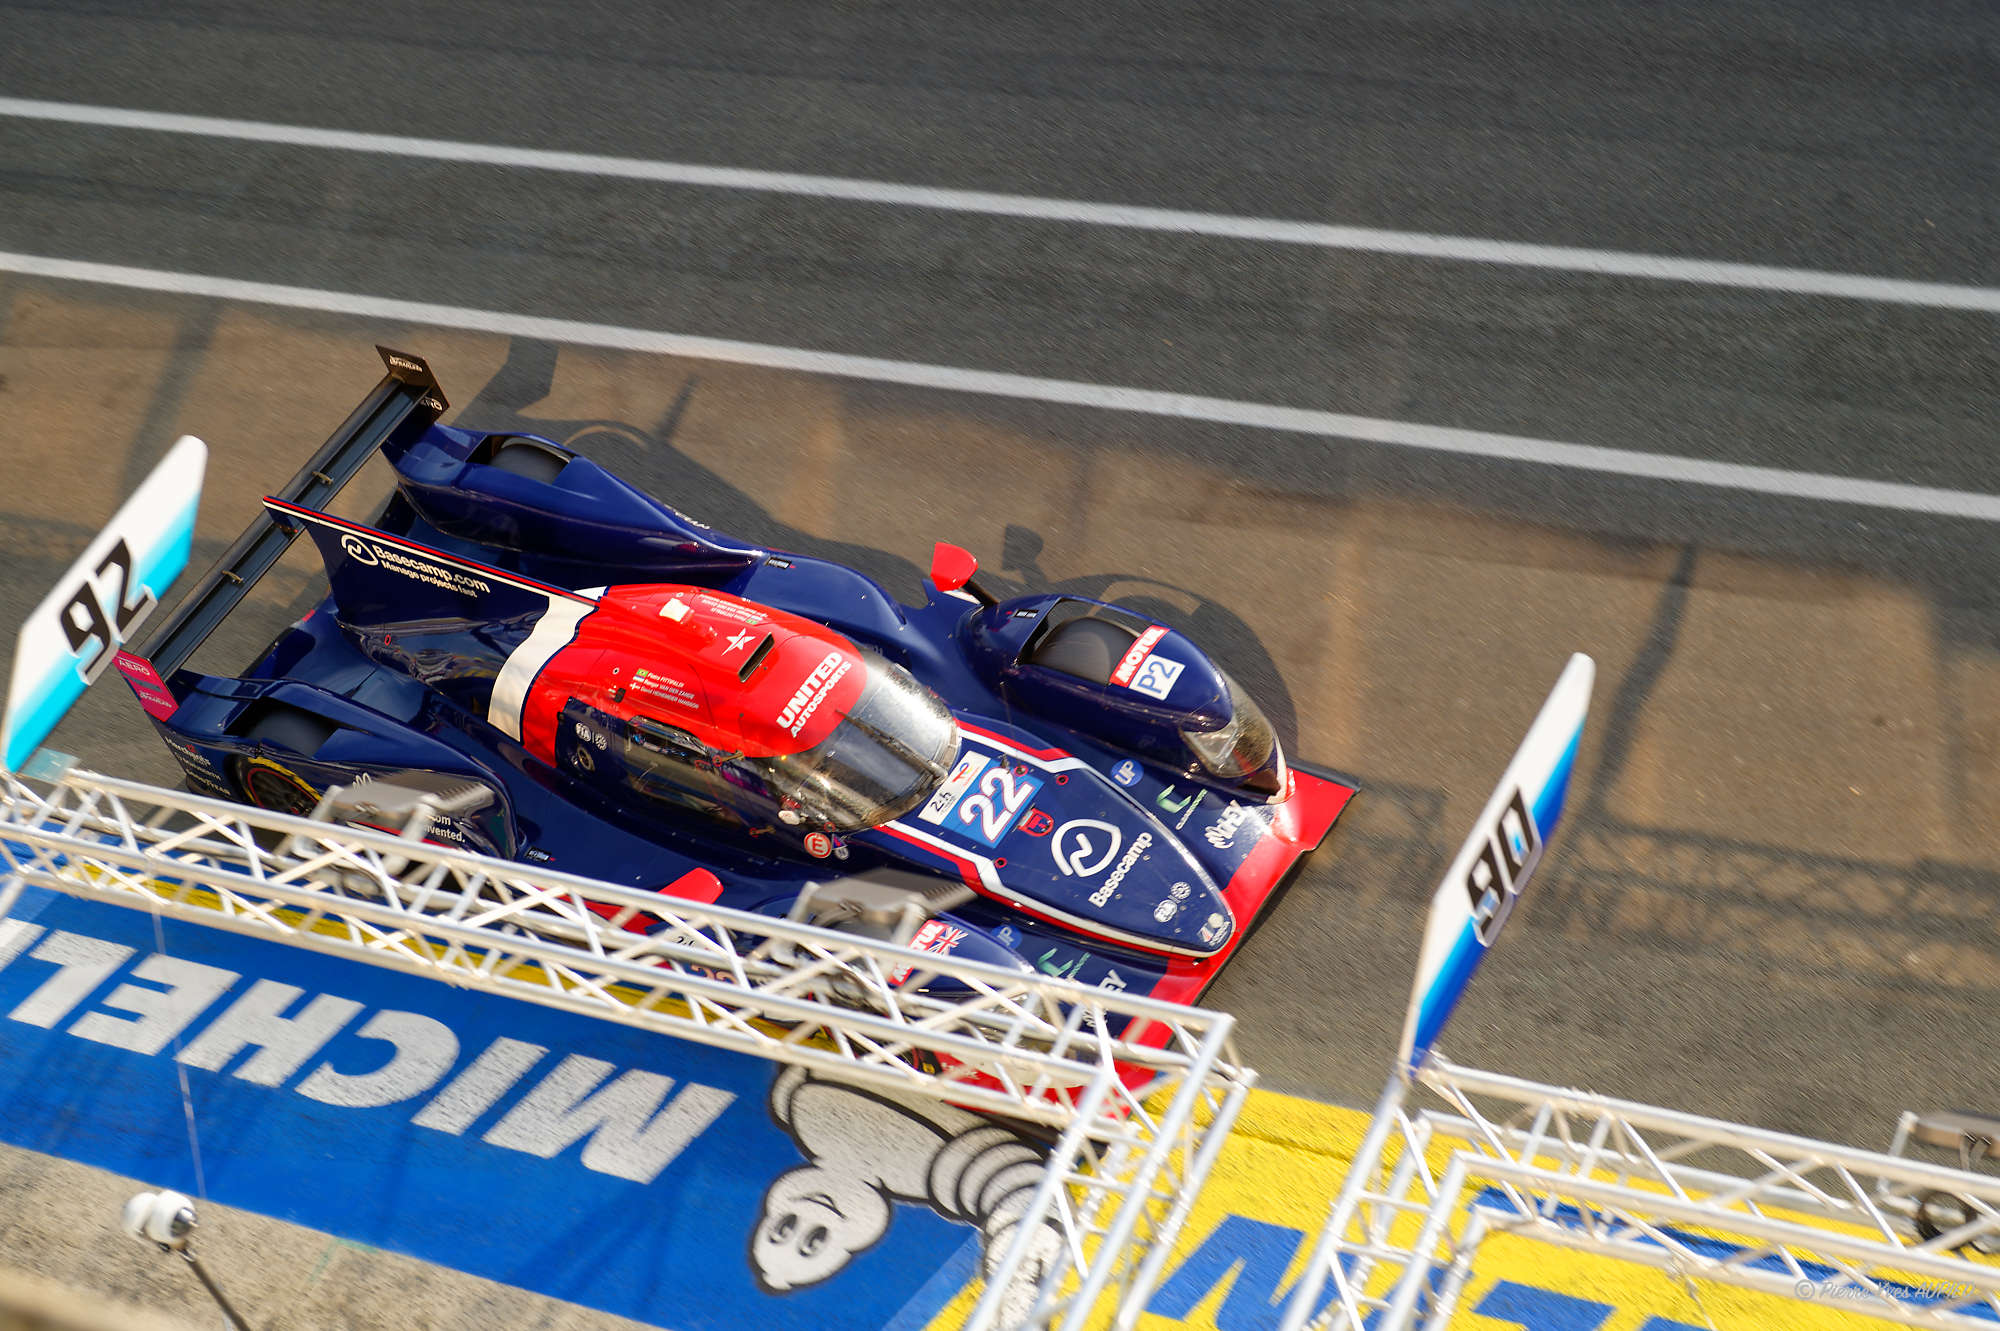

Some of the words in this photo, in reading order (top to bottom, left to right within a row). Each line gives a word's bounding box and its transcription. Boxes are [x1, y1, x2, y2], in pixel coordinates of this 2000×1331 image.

[60, 538, 149, 676] 92
[372, 545, 491, 594] Basecamp.com
[381, 561, 420, 580] Manage
[420, 574, 460, 592] projects
[776, 652, 843, 729] UNITED
[1115, 629, 1165, 684] MOTUL
[1137, 661, 1177, 694] P2
[790, 661, 853, 739] AUTOSPORTS
[959, 767, 1035, 843] 22
[1114, 760, 1136, 785] UP
[1088, 832, 1153, 908] Basecamp
[1467, 787, 1534, 938] 90
